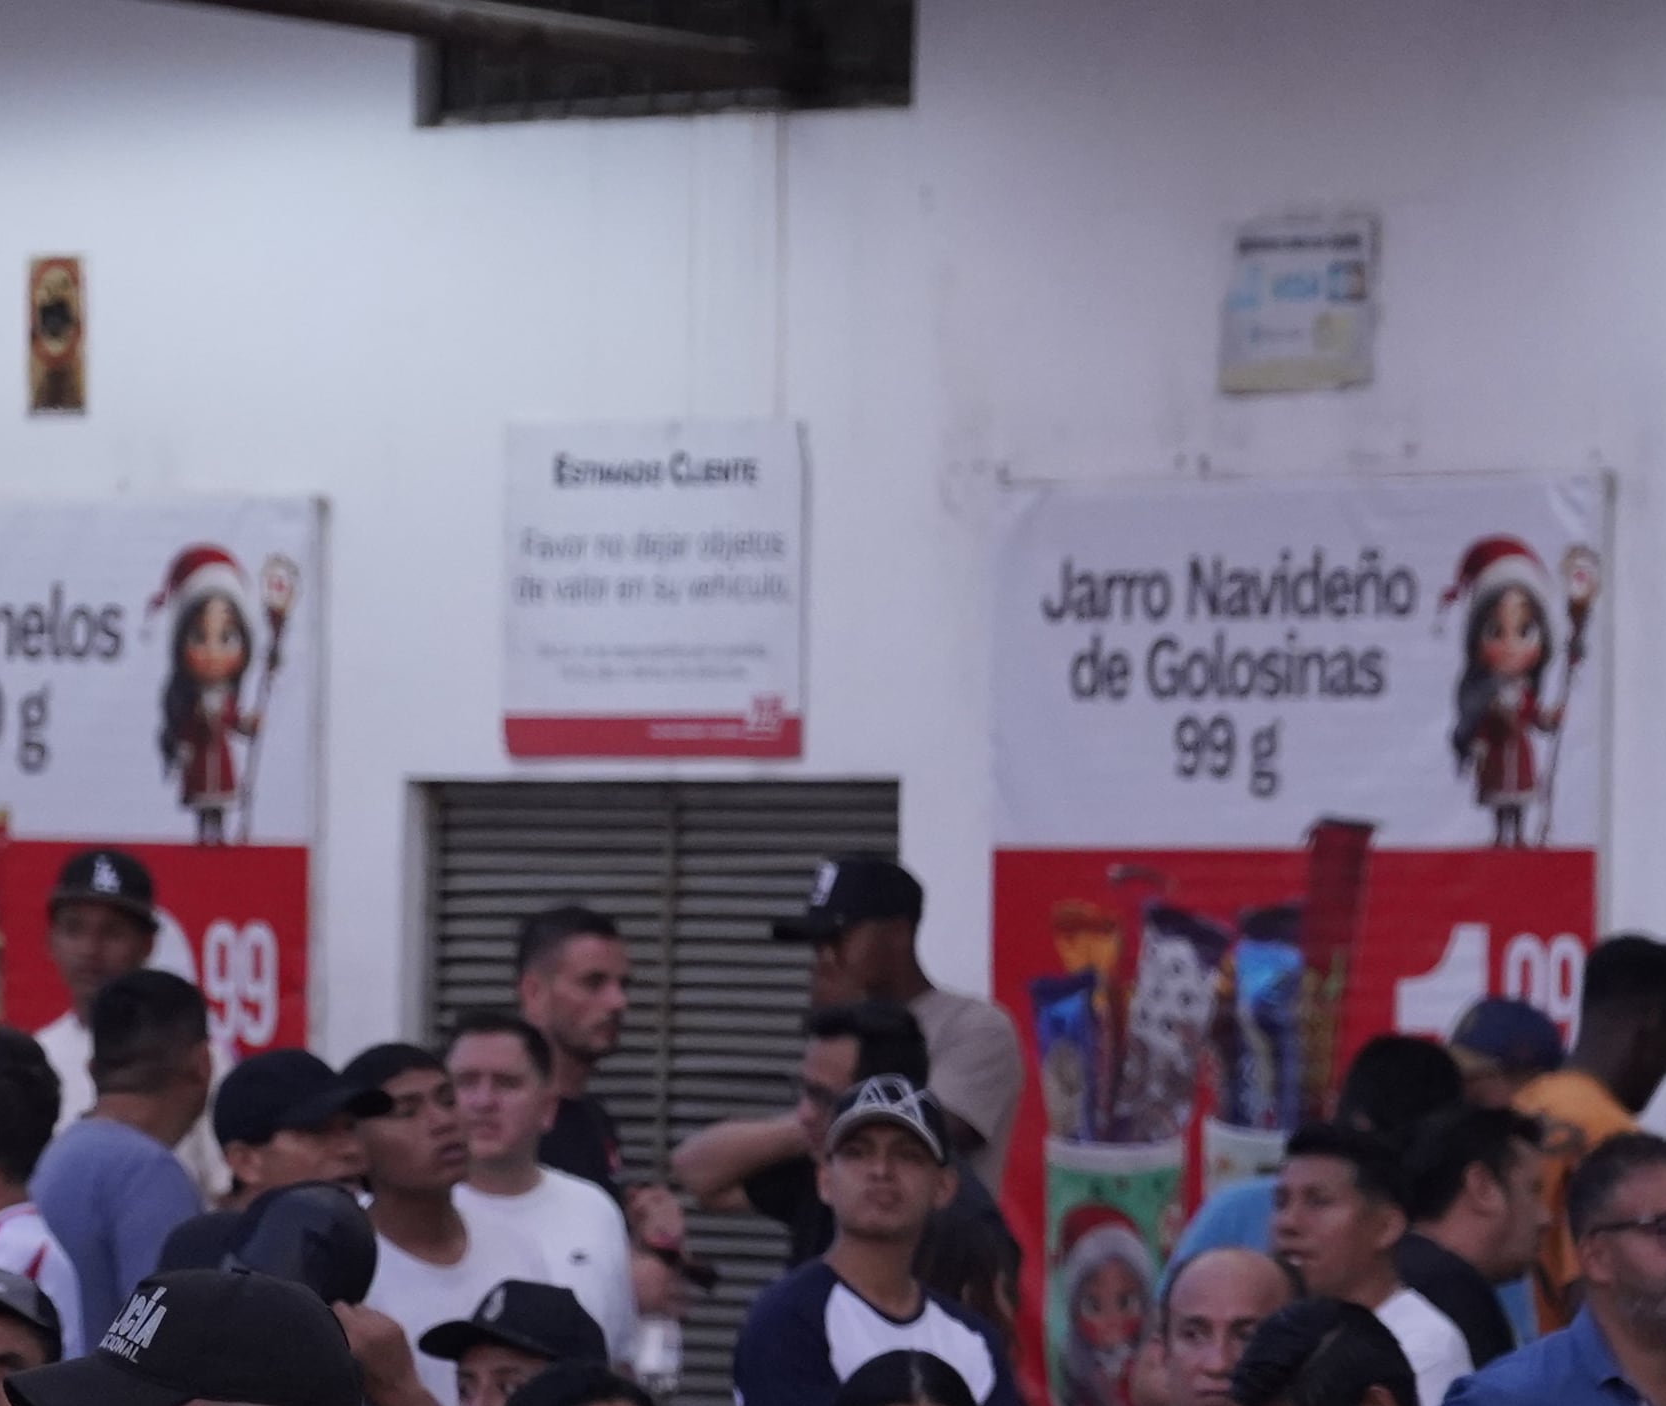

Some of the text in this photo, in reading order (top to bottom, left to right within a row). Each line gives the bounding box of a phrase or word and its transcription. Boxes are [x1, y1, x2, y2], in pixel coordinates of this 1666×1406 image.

[1041, 547, 1417, 622] Jarro Navideño
[1069, 630, 1387, 698] de Golosinas
[17, 682, 53, 775] g
[1175, 714, 1285, 798] 99 g
